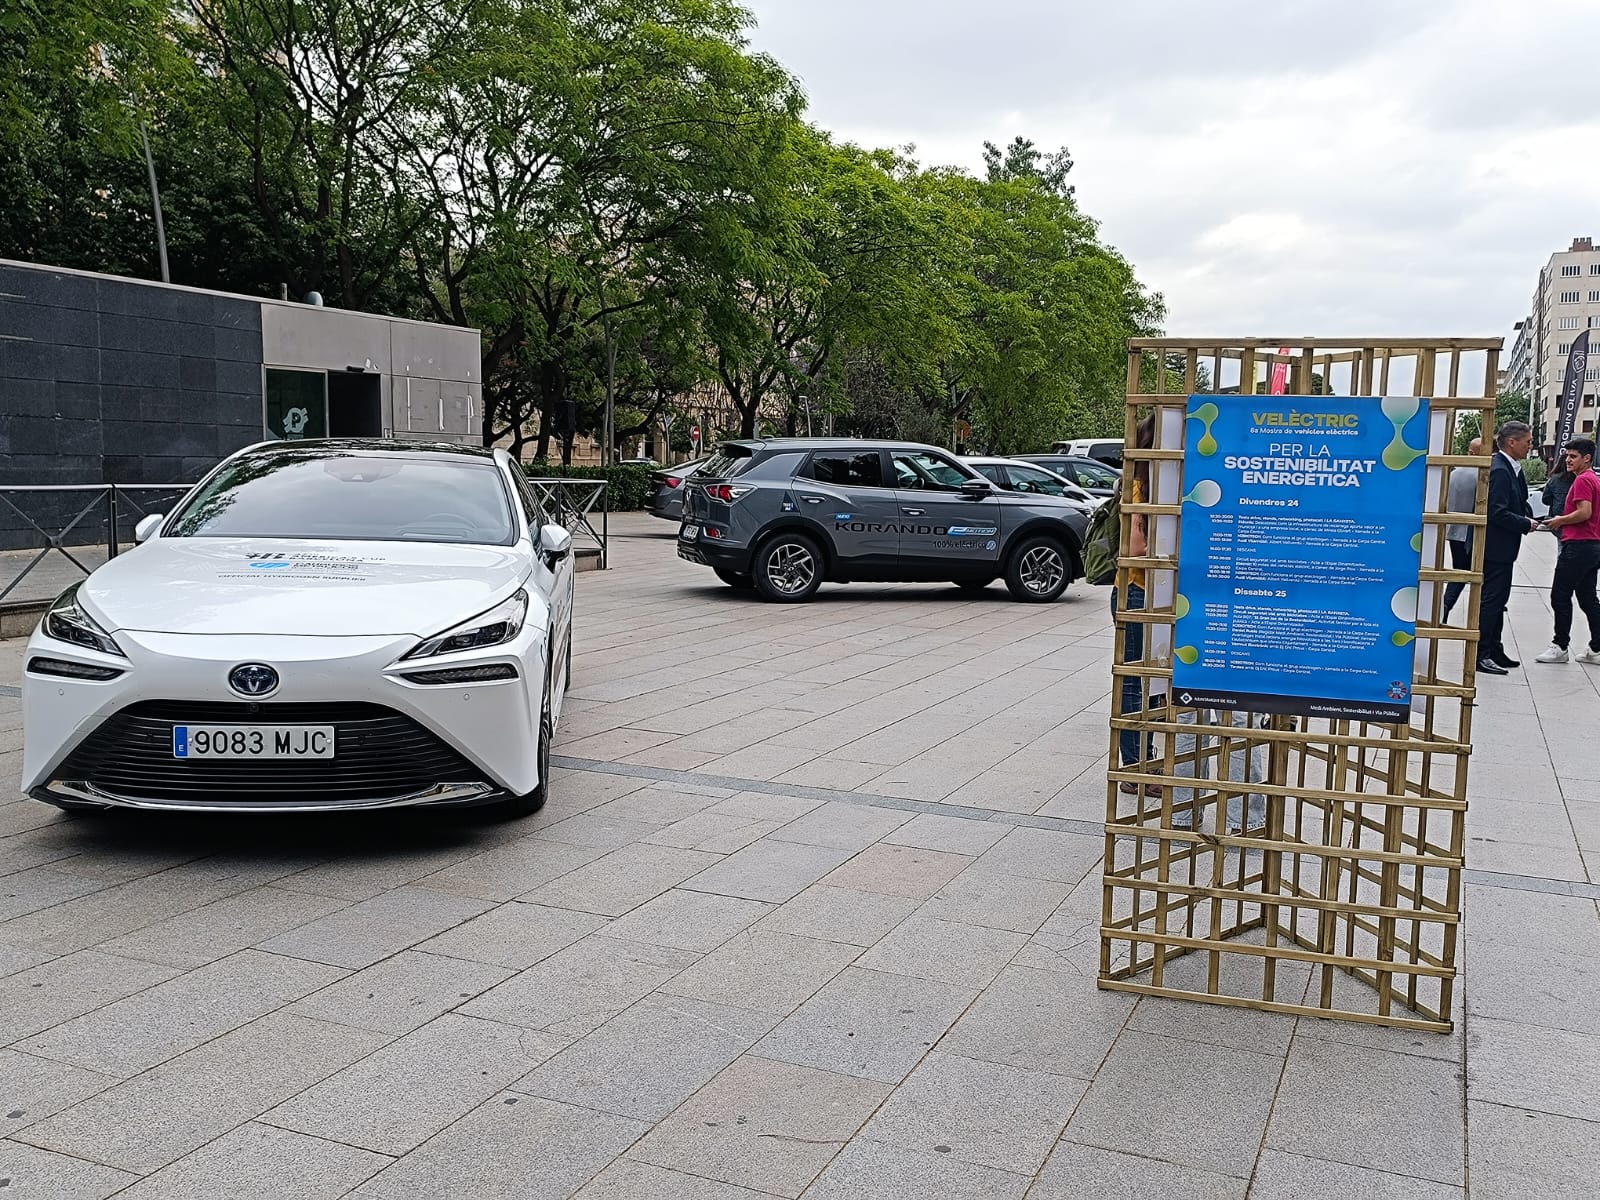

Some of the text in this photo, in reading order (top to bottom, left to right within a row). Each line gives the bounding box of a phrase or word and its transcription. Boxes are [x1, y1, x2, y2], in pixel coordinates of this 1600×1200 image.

[1252, 409, 1359, 428] VELÈCTRIC
[1560, 379, 1578, 457] OAQUIN OLIVA
[1269, 443, 1331, 458] PER LA
[1224, 456, 1377, 474] SOSTENIBILITAT
[1242, 469, 1361, 487] ENERGÈTICA
[1239, 497, 1299, 507] Divendres 24
[835, 522, 947, 536] KORANDO
[934, 540, 954, 548] 100%
[1234, 587, 1287, 598] Dissabte 25
[194, 731, 326, 755] 9083 MJC
